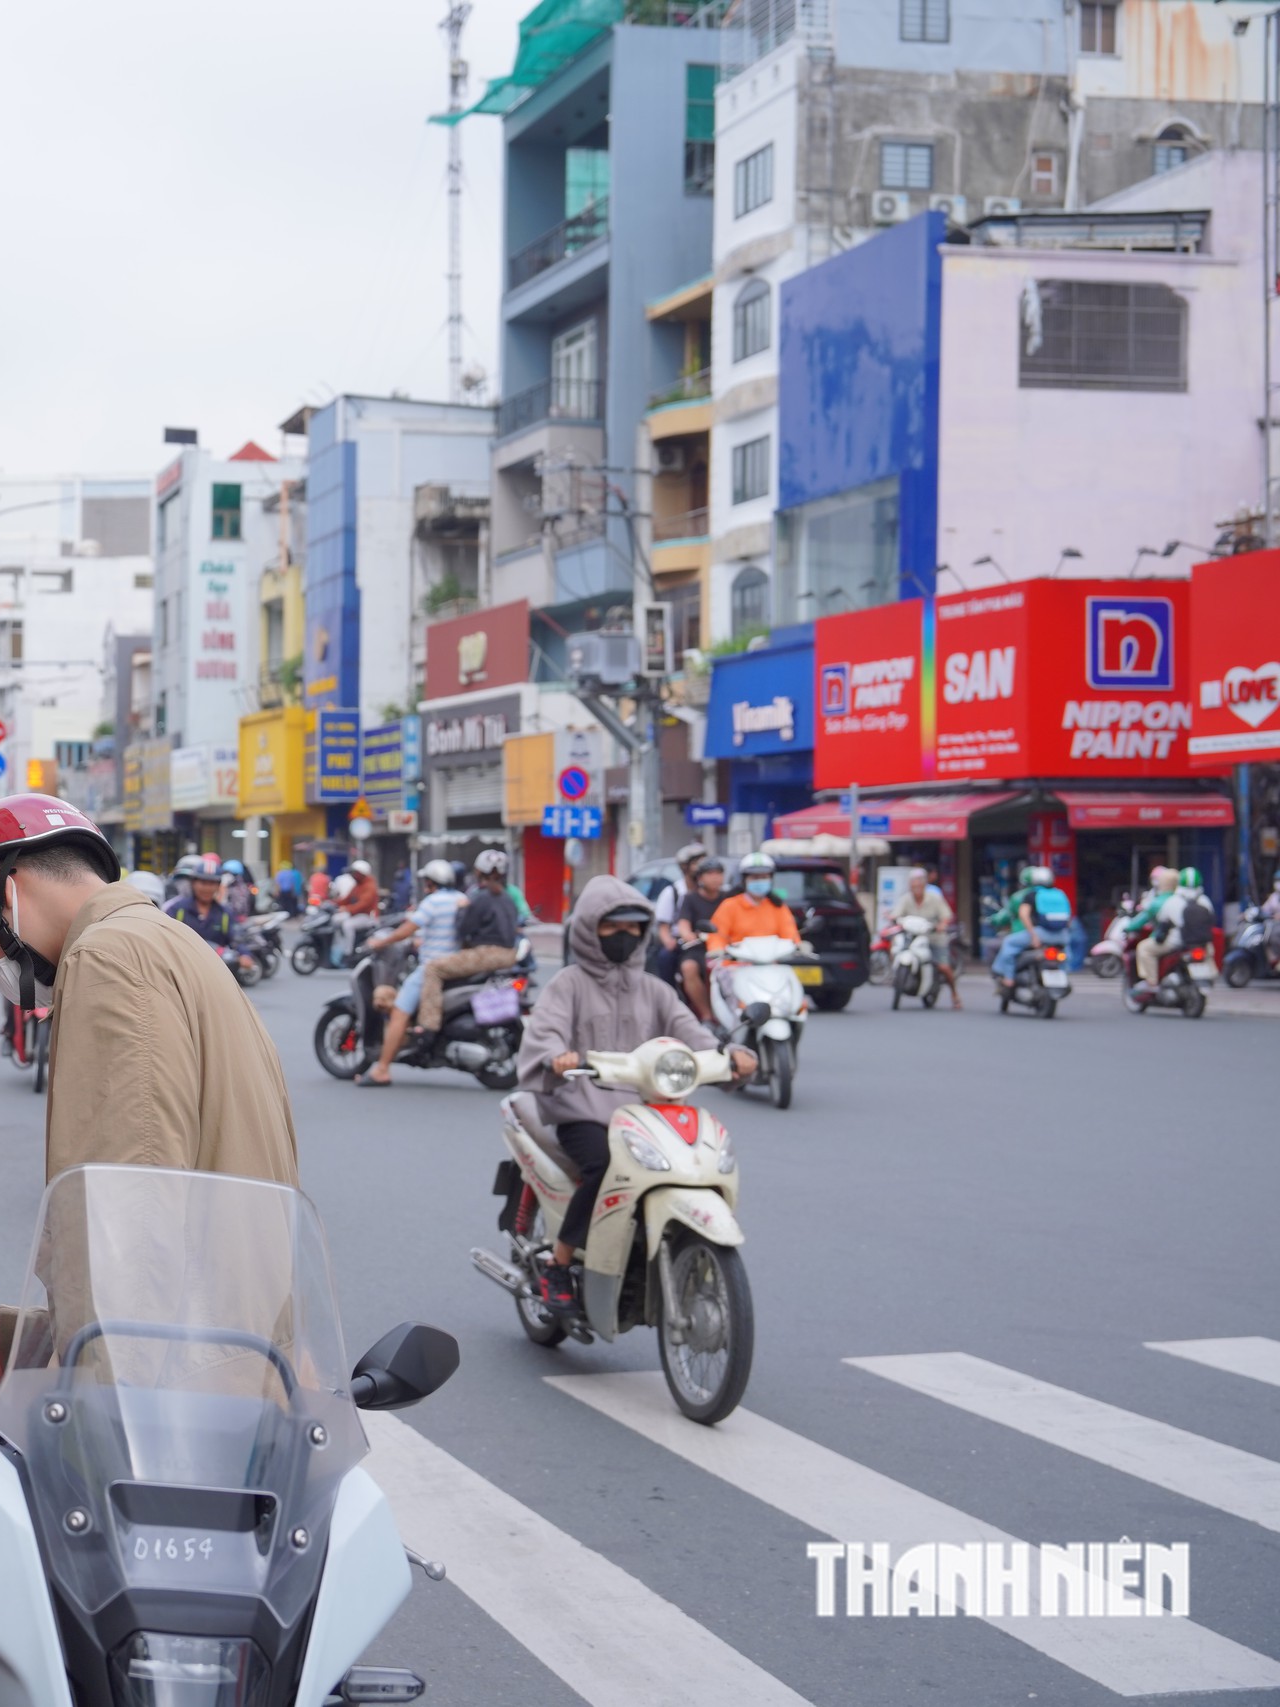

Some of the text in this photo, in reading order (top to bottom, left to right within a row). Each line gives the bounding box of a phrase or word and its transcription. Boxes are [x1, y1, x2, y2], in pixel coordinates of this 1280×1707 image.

[851, 656, 915, 687] NIPPON
[944, 646, 1016, 704] SAN
[853, 680, 904, 710] PAINT
[1228, 675, 1278, 705] LOVE
[1062, 700, 1193, 731] NIPPON
[1070, 729, 1177, 760] PAINT
[134, 1537, 213, 1562] 01654
